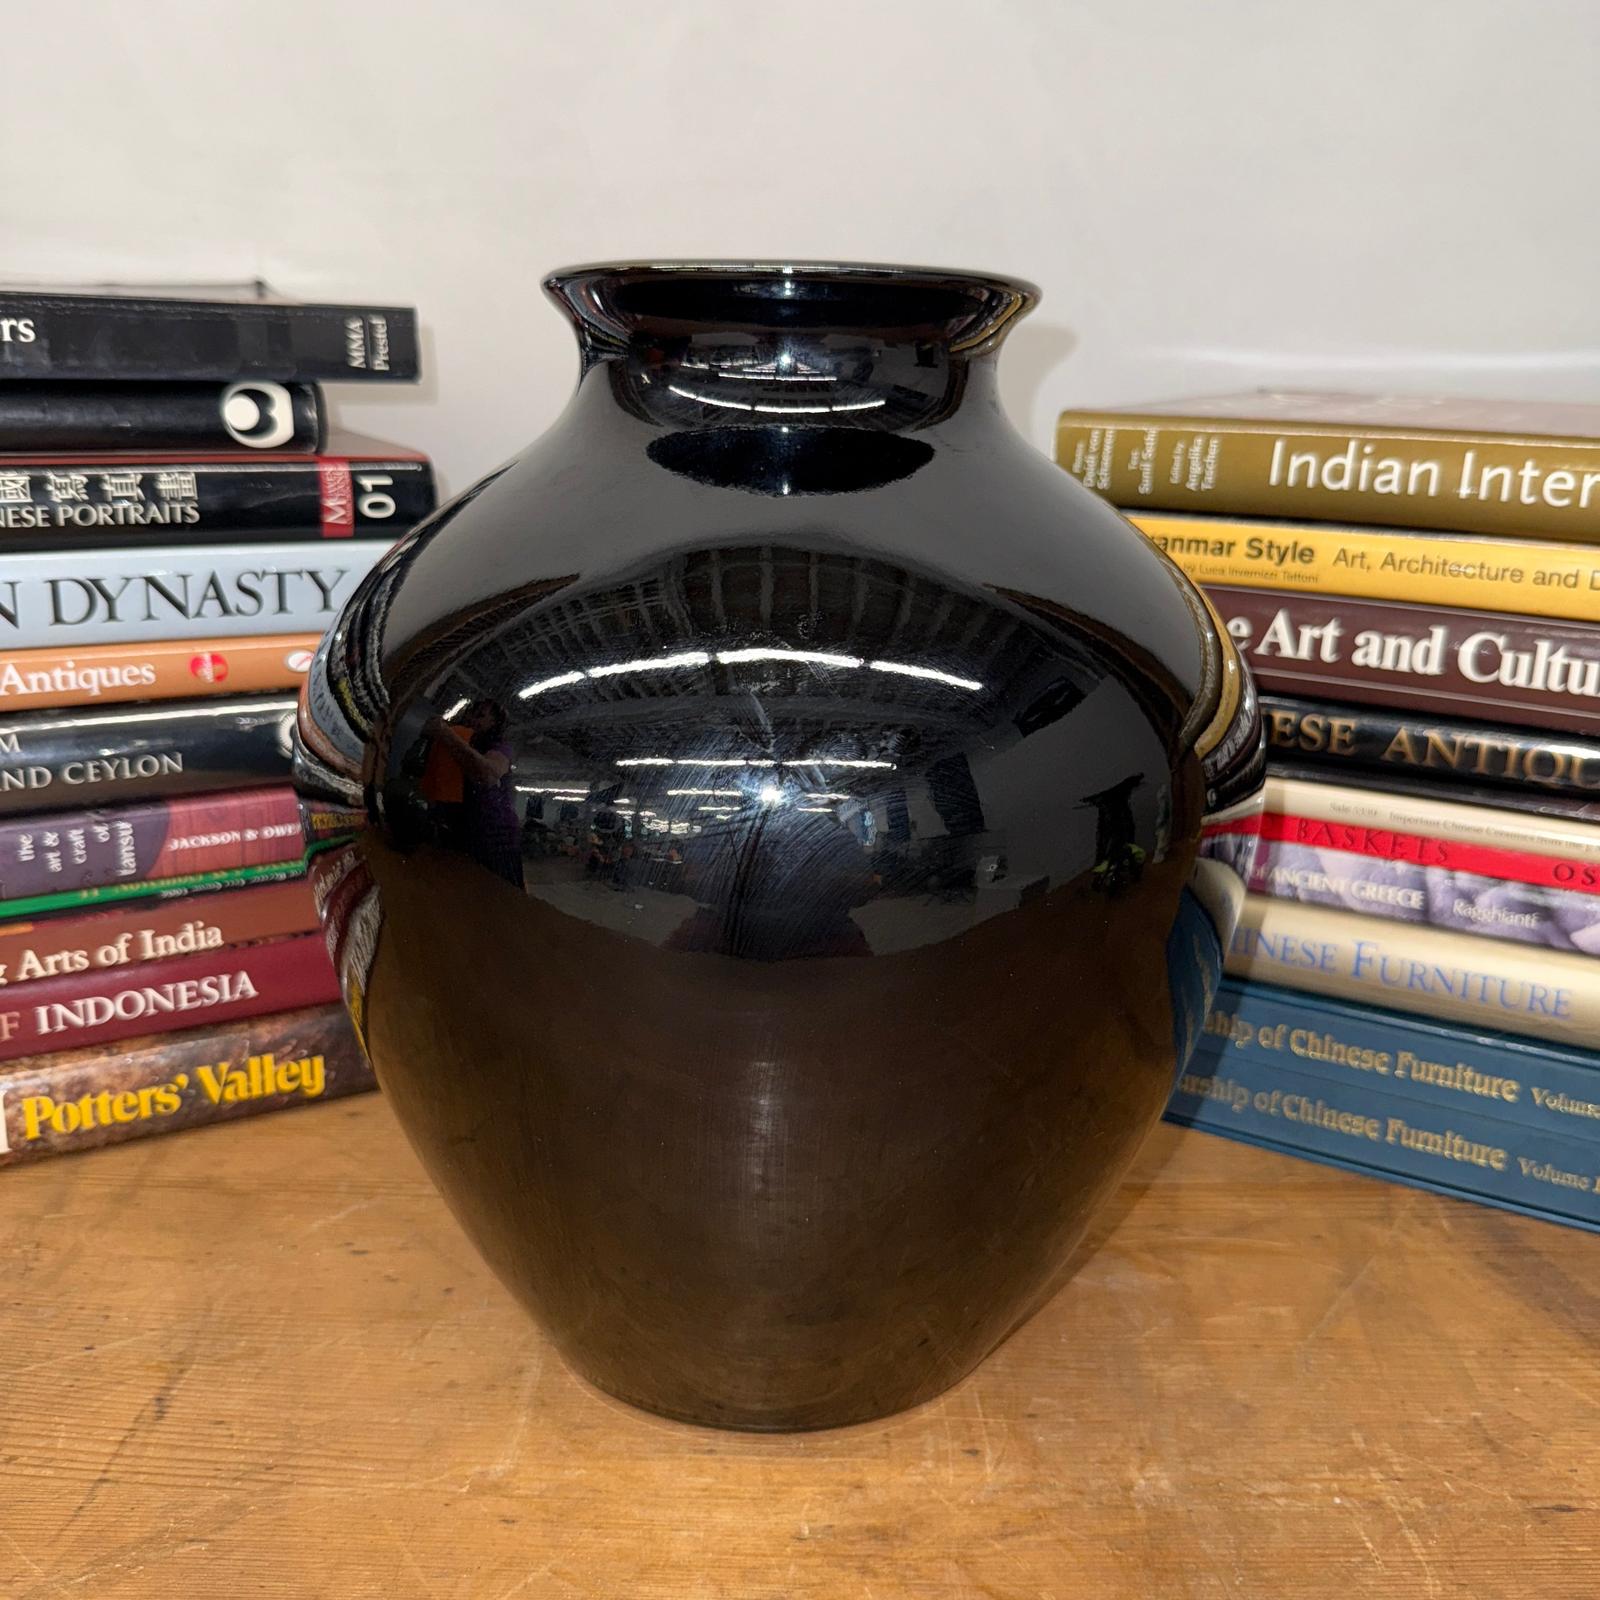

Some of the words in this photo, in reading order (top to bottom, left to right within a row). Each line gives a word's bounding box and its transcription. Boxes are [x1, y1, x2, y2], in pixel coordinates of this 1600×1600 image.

[0, 317, 36, 343] rs
[345, 315, 366, 369] MMA
[357, 474, 396, 519] 01
[1269, 437, 1441, 497] Indian
[1458, 450, 1600, 508] Inter
[0, 503, 51, 528] NESE
[55, 501, 201, 527] PORTRAITS
[1152, 536, 1236, 557] anmar
[1246, 537, 1315, 567] Style
[1333, 548, 1372, 572] Art,
[1379, 551, 1523, 583] Architecture
[1532, 568, 1579, 590] and
[45, 568, 349, 627] DYNASTY
[0, 660, 156, 696] Antiques
[1254, 608, 1344, 663] Art
[1352, 624, 1449, 675] and
[1457, 631, 1600, 697] Cultu
[1270, 710, 1356, 755] ESE
[59, 752, 184, 785] CEYLON
[168, 830, 241, 851] JACKSON
[242, 828, 259, 842] &
[1296, 820, 1449, 865] BASKETS
[1271, 868, 1347, 900] ANCIENT
[1350, 879, 1425, 911] GREECE
[17, 947, 89, 981] Arts
[97, 933, 130, 966] of
[138, 920, 225, 959] India
[34, 970, 259, 1036] INDONESIA
[1351, 938, 1575, 1020] FURNITURE
[196, 1053, 326, 1106] Valley
[1257, 1023, 1290, 1051] of
[1289, 1028, 1391, 1075] Chinese
[1394, 1050, 1521, 1104] Furniture
[1253, 1089, 1282, 1116] of
[1281, 1095, 1382, 1142] Chinese
[1385, 1117, 1510, 1171] Furniture
[1517, 1156, 1590, 1192] Volume
